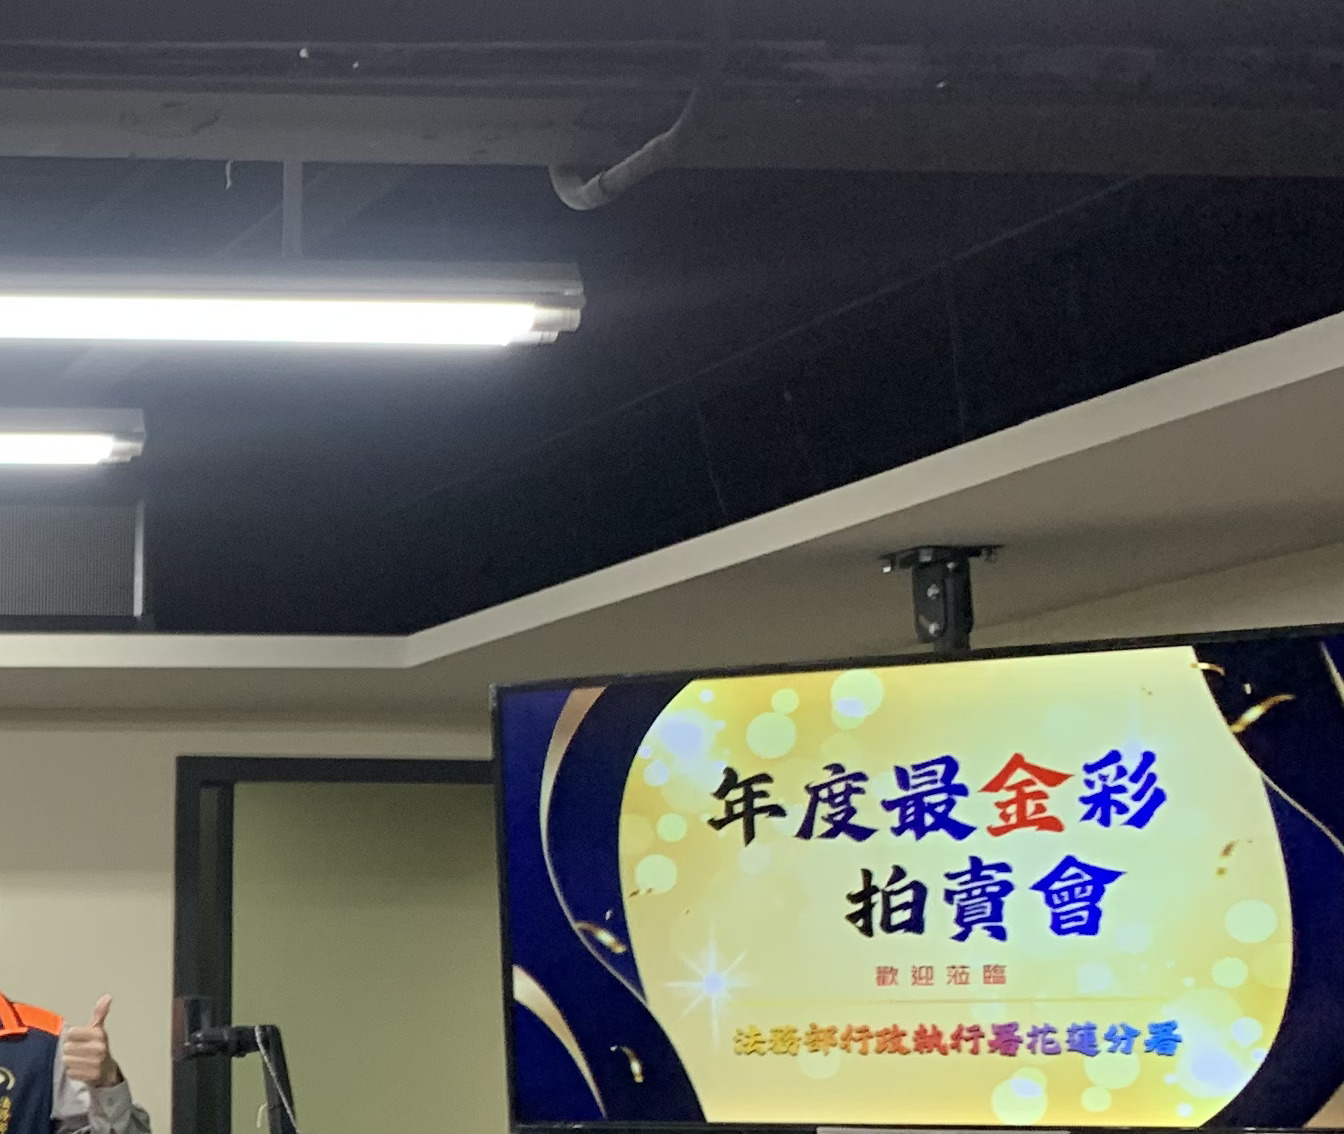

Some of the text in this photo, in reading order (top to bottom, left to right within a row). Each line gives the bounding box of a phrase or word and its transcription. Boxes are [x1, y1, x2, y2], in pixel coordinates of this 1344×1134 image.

[707, 748, 1170, 847] 年度最金彩
[846, 854, 1127, 943] 拍賣會
[875, 963, 1009, 988] 歡迎蒞臨
[733, 1018, 1184, 1059] 法務部行政執行署花蓮分署
